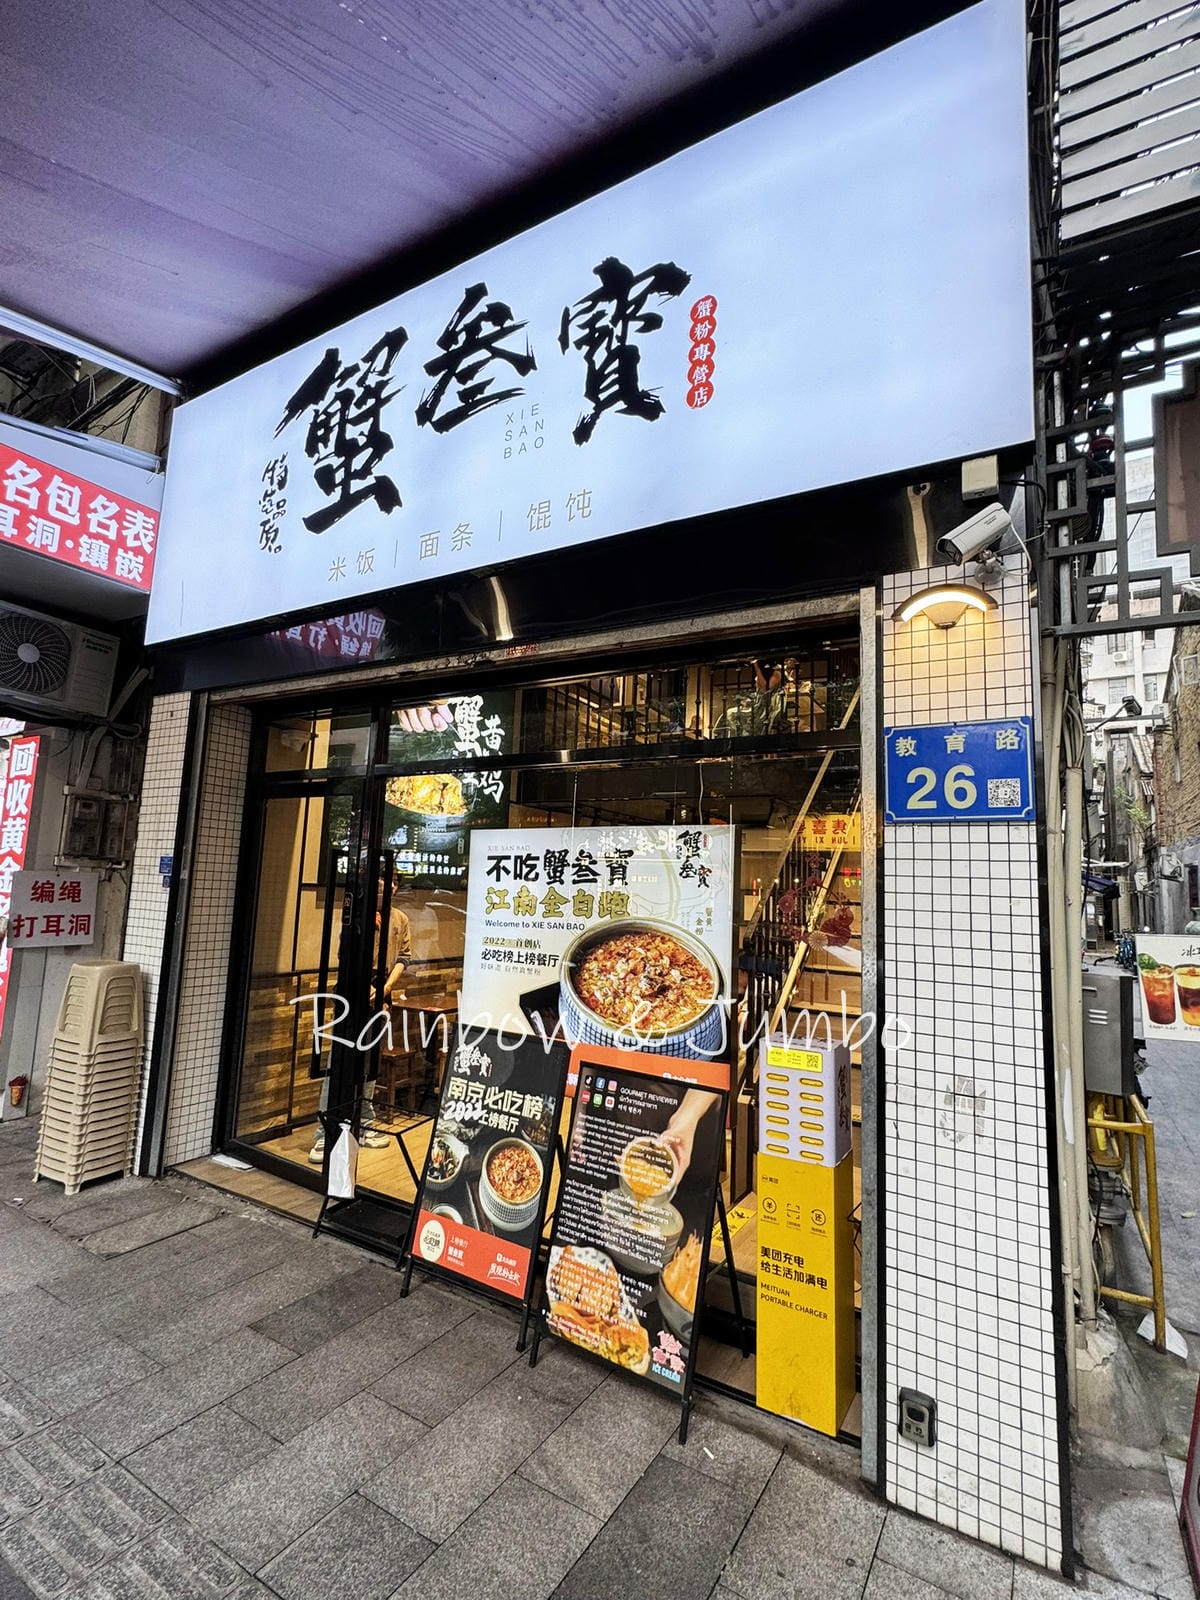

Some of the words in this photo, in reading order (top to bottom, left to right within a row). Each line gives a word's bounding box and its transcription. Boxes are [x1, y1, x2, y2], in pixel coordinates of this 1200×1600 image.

[273, 256, 692, 535] 蟹叁寶
[505, 403, 540, 425] XIE
[504, 418, 544, 442] SAN
[503, 436, 544, 459] BAO
[3, 459, 156, 555] 名包名表
[328, 547, 376, 583] 米饭
[419, 522, 473, 561] 面条
[526, 488, 593, 532] 馄饨
[895, 728, 1020, 757] 教育路
[906, 764, 977, 810] 26
[30, 880, 82, 904] 编绳
[485, 885, 631, 920] 江南全白跑
[13, 914, 91, 938] 打耳洞
[485, 919, 520, 929] Welcome
[522, 921, 529, 929] to
[531, 921, 546, 930] XIE
[546, 921, 565, 930] SAN
[566, 922, 585, 931] BAO
[484, 936, 505, 946] 2022
[481, 948, 560, 967] 必吃榜上榜餐厅
[447, 1076, 543, 1121] 南京必吃榜
[620, 1087, 648, 1099] GOURMET
[647, 1093, 678, 1106] REVIEWER
[478, 1111, 519, 1133] 上榜餐厅
[761, 1245, 804, 1269] 美团充电
[760, 1260, 828, 1290] 给生活加满电
[761, 1282, 790, 1297] MEITUAN
[761, 1293, 794, 1310] PORTABLE
[795, 1304, 828, 1320] CHARGER
